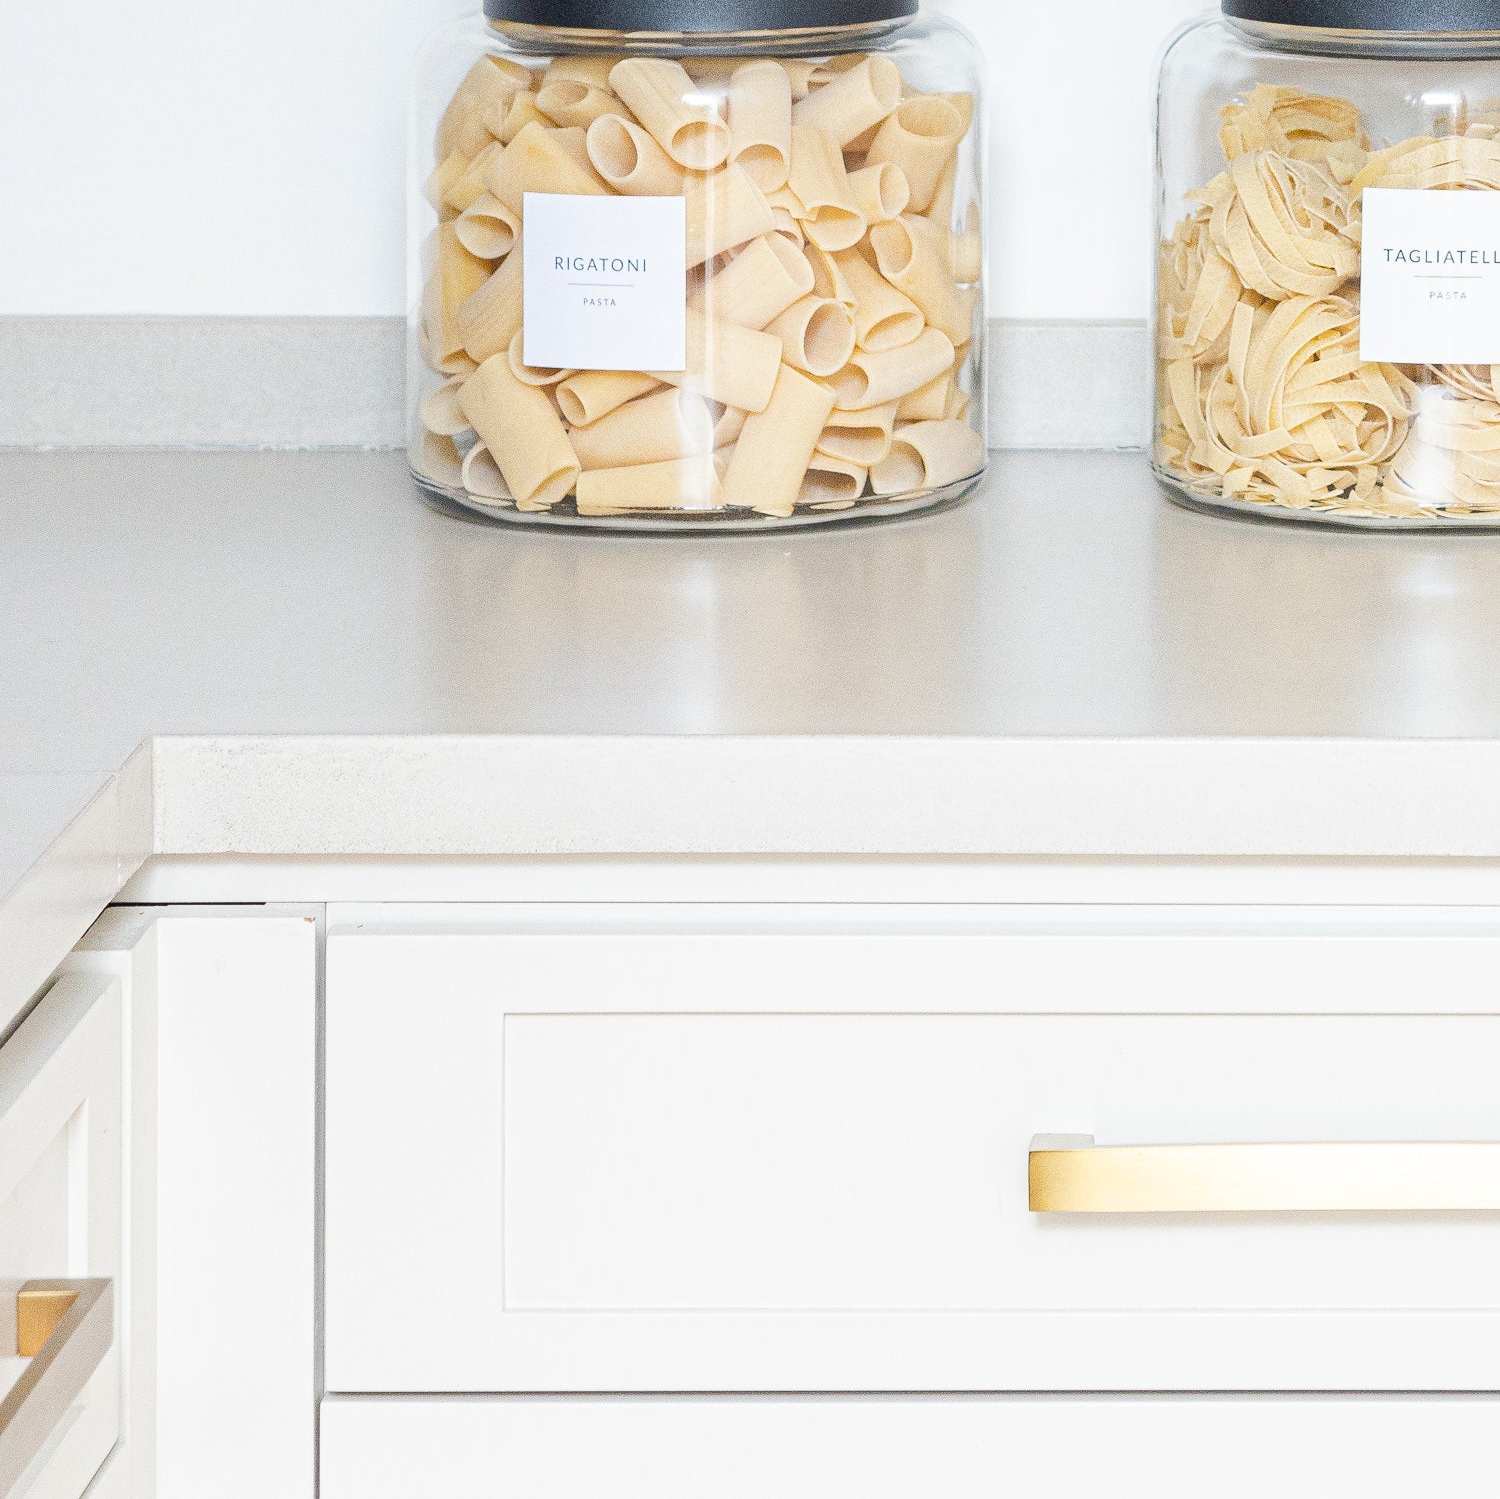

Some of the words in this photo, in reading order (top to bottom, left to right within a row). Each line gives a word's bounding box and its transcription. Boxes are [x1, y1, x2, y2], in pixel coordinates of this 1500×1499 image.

[554, 256, 647, 274] RIGATONI
[1429, 290, 1467, 300] PASTA
[583, 297, 617, 307] PASTA
